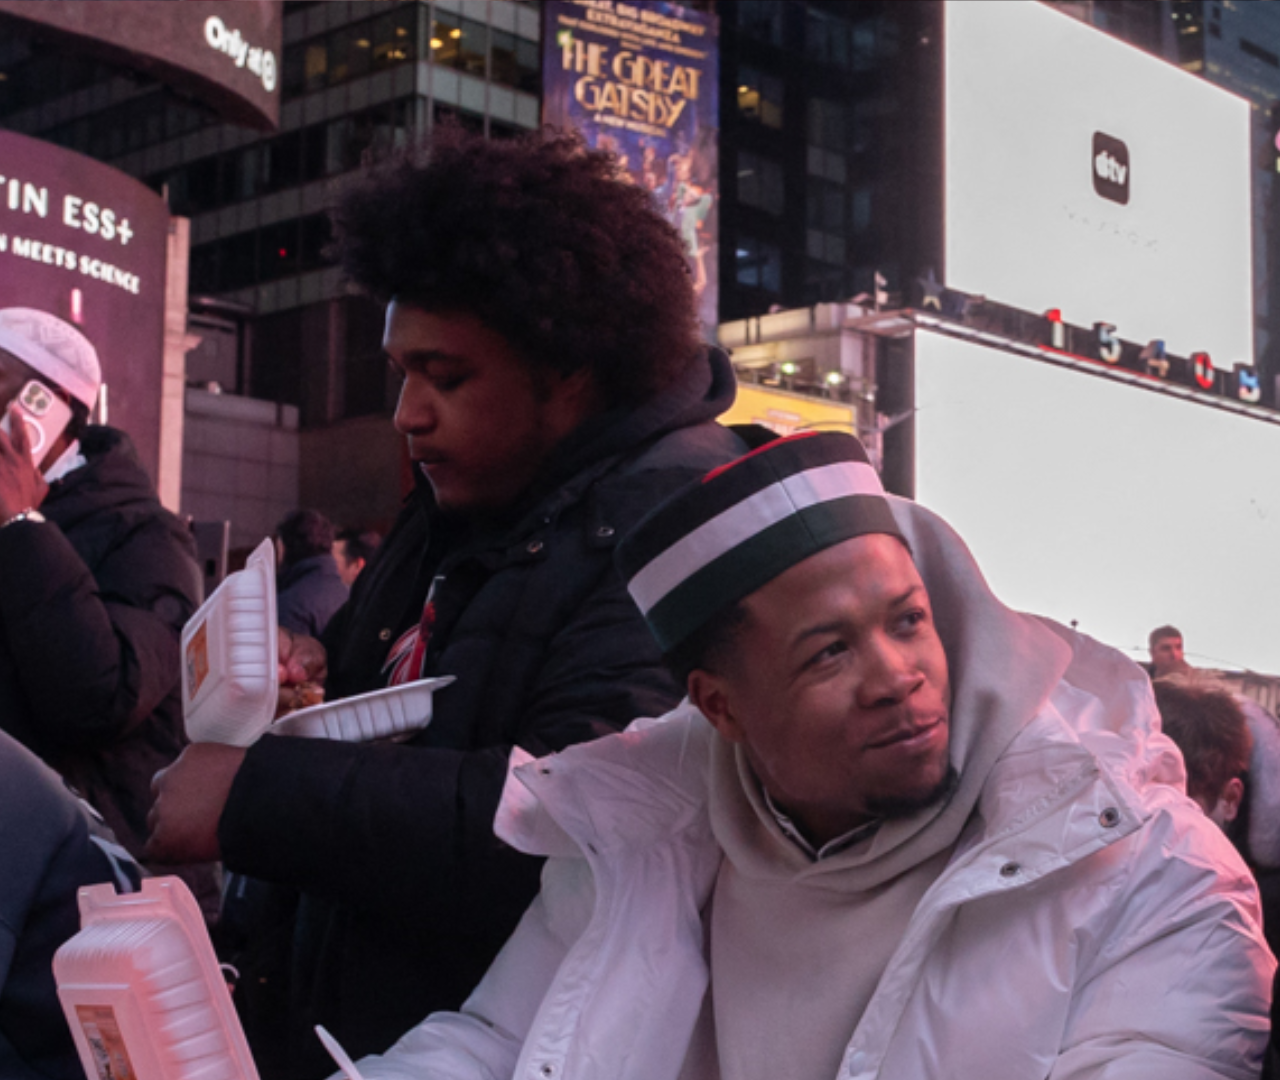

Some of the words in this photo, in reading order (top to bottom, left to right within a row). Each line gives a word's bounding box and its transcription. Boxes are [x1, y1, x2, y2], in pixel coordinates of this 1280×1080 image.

[204, 15, 248, 68] Only
[560, 30, 608, 79] THE
[612, 51, 703, 100] GREAT
[575, 75, 687, 128] GATSBY
[62, 194, 134, 246] ESS+
[12, 236, 77, 271] MEETS
